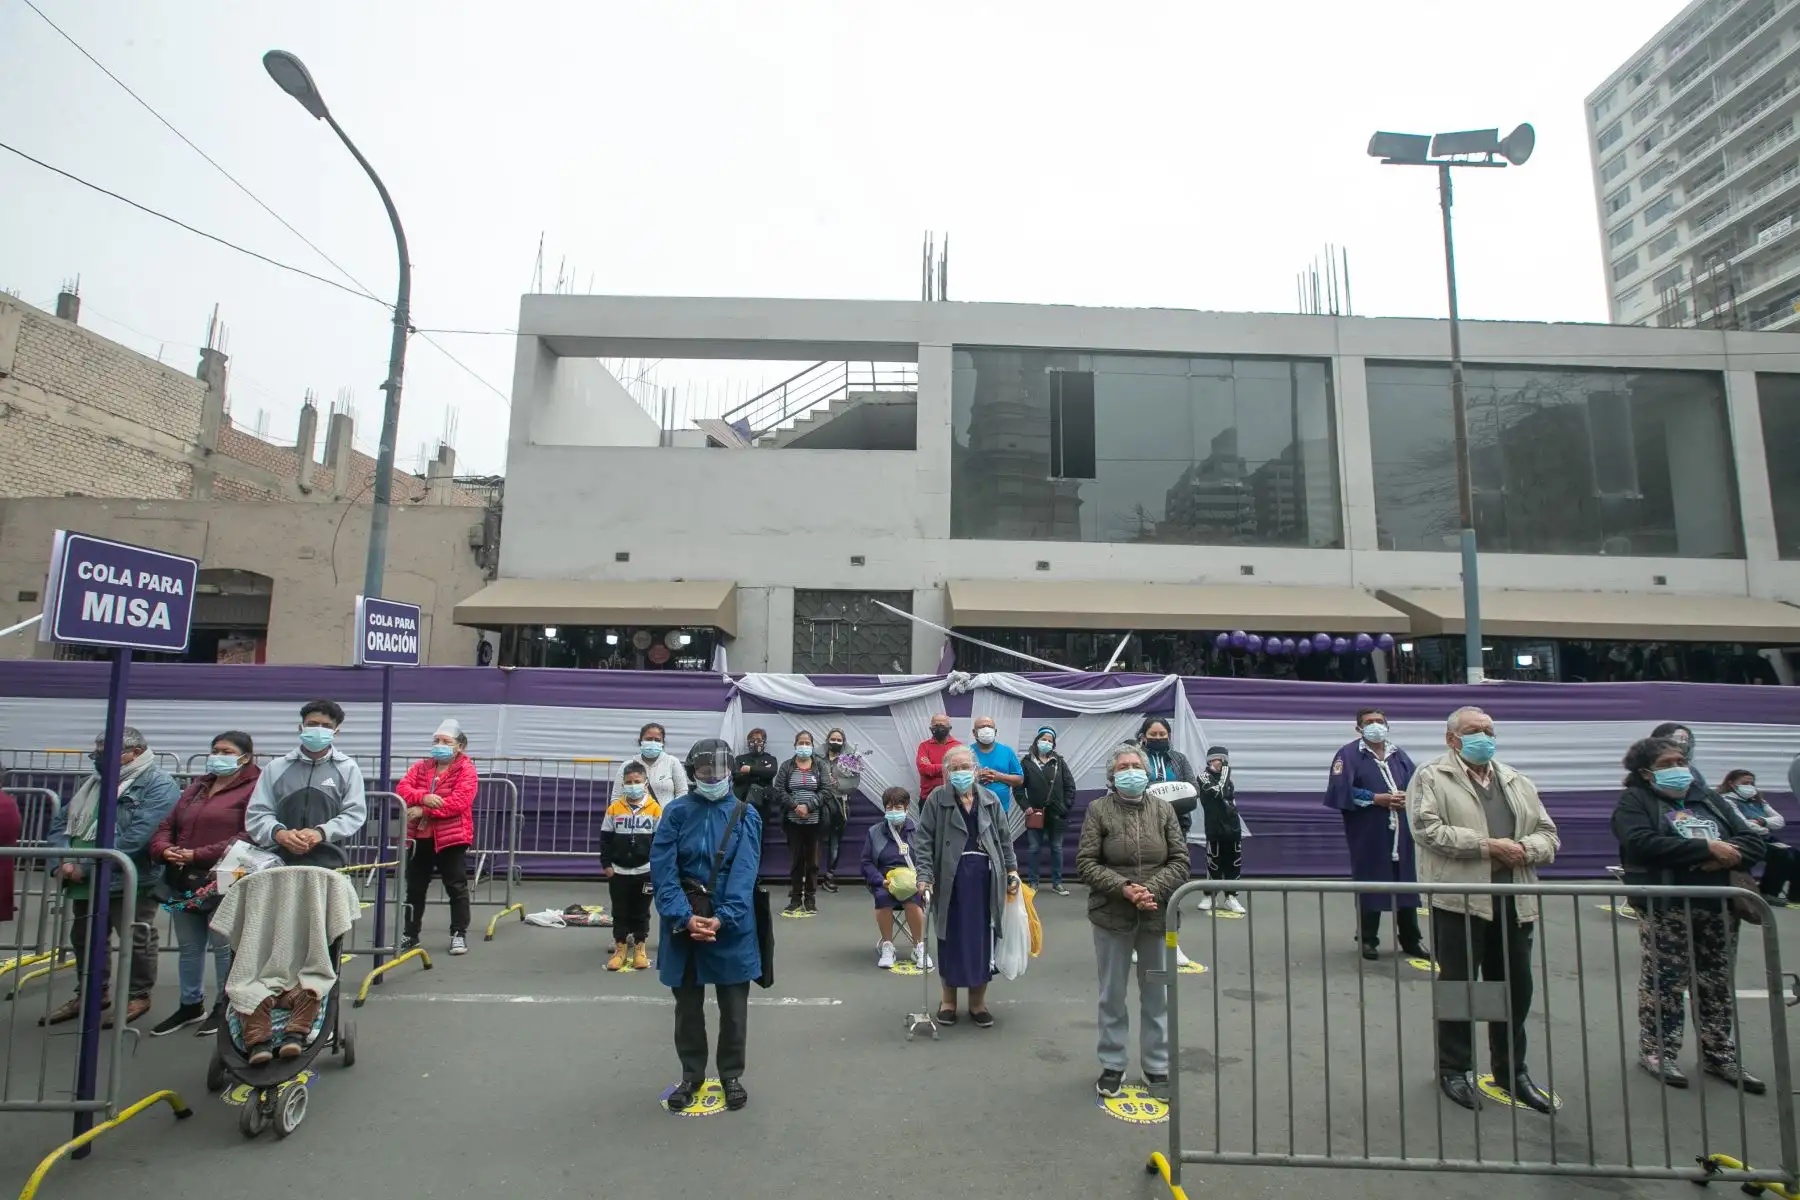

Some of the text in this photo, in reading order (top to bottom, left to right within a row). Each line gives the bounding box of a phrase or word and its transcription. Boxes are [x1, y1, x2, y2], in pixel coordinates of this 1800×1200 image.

[78, 561, 184, 596] COLA PARA
[81, 591, 171, 630] MISA
[370, 613, 416, 630] COLA PARA
[367, 631, 417, 654] ORACIÓN
